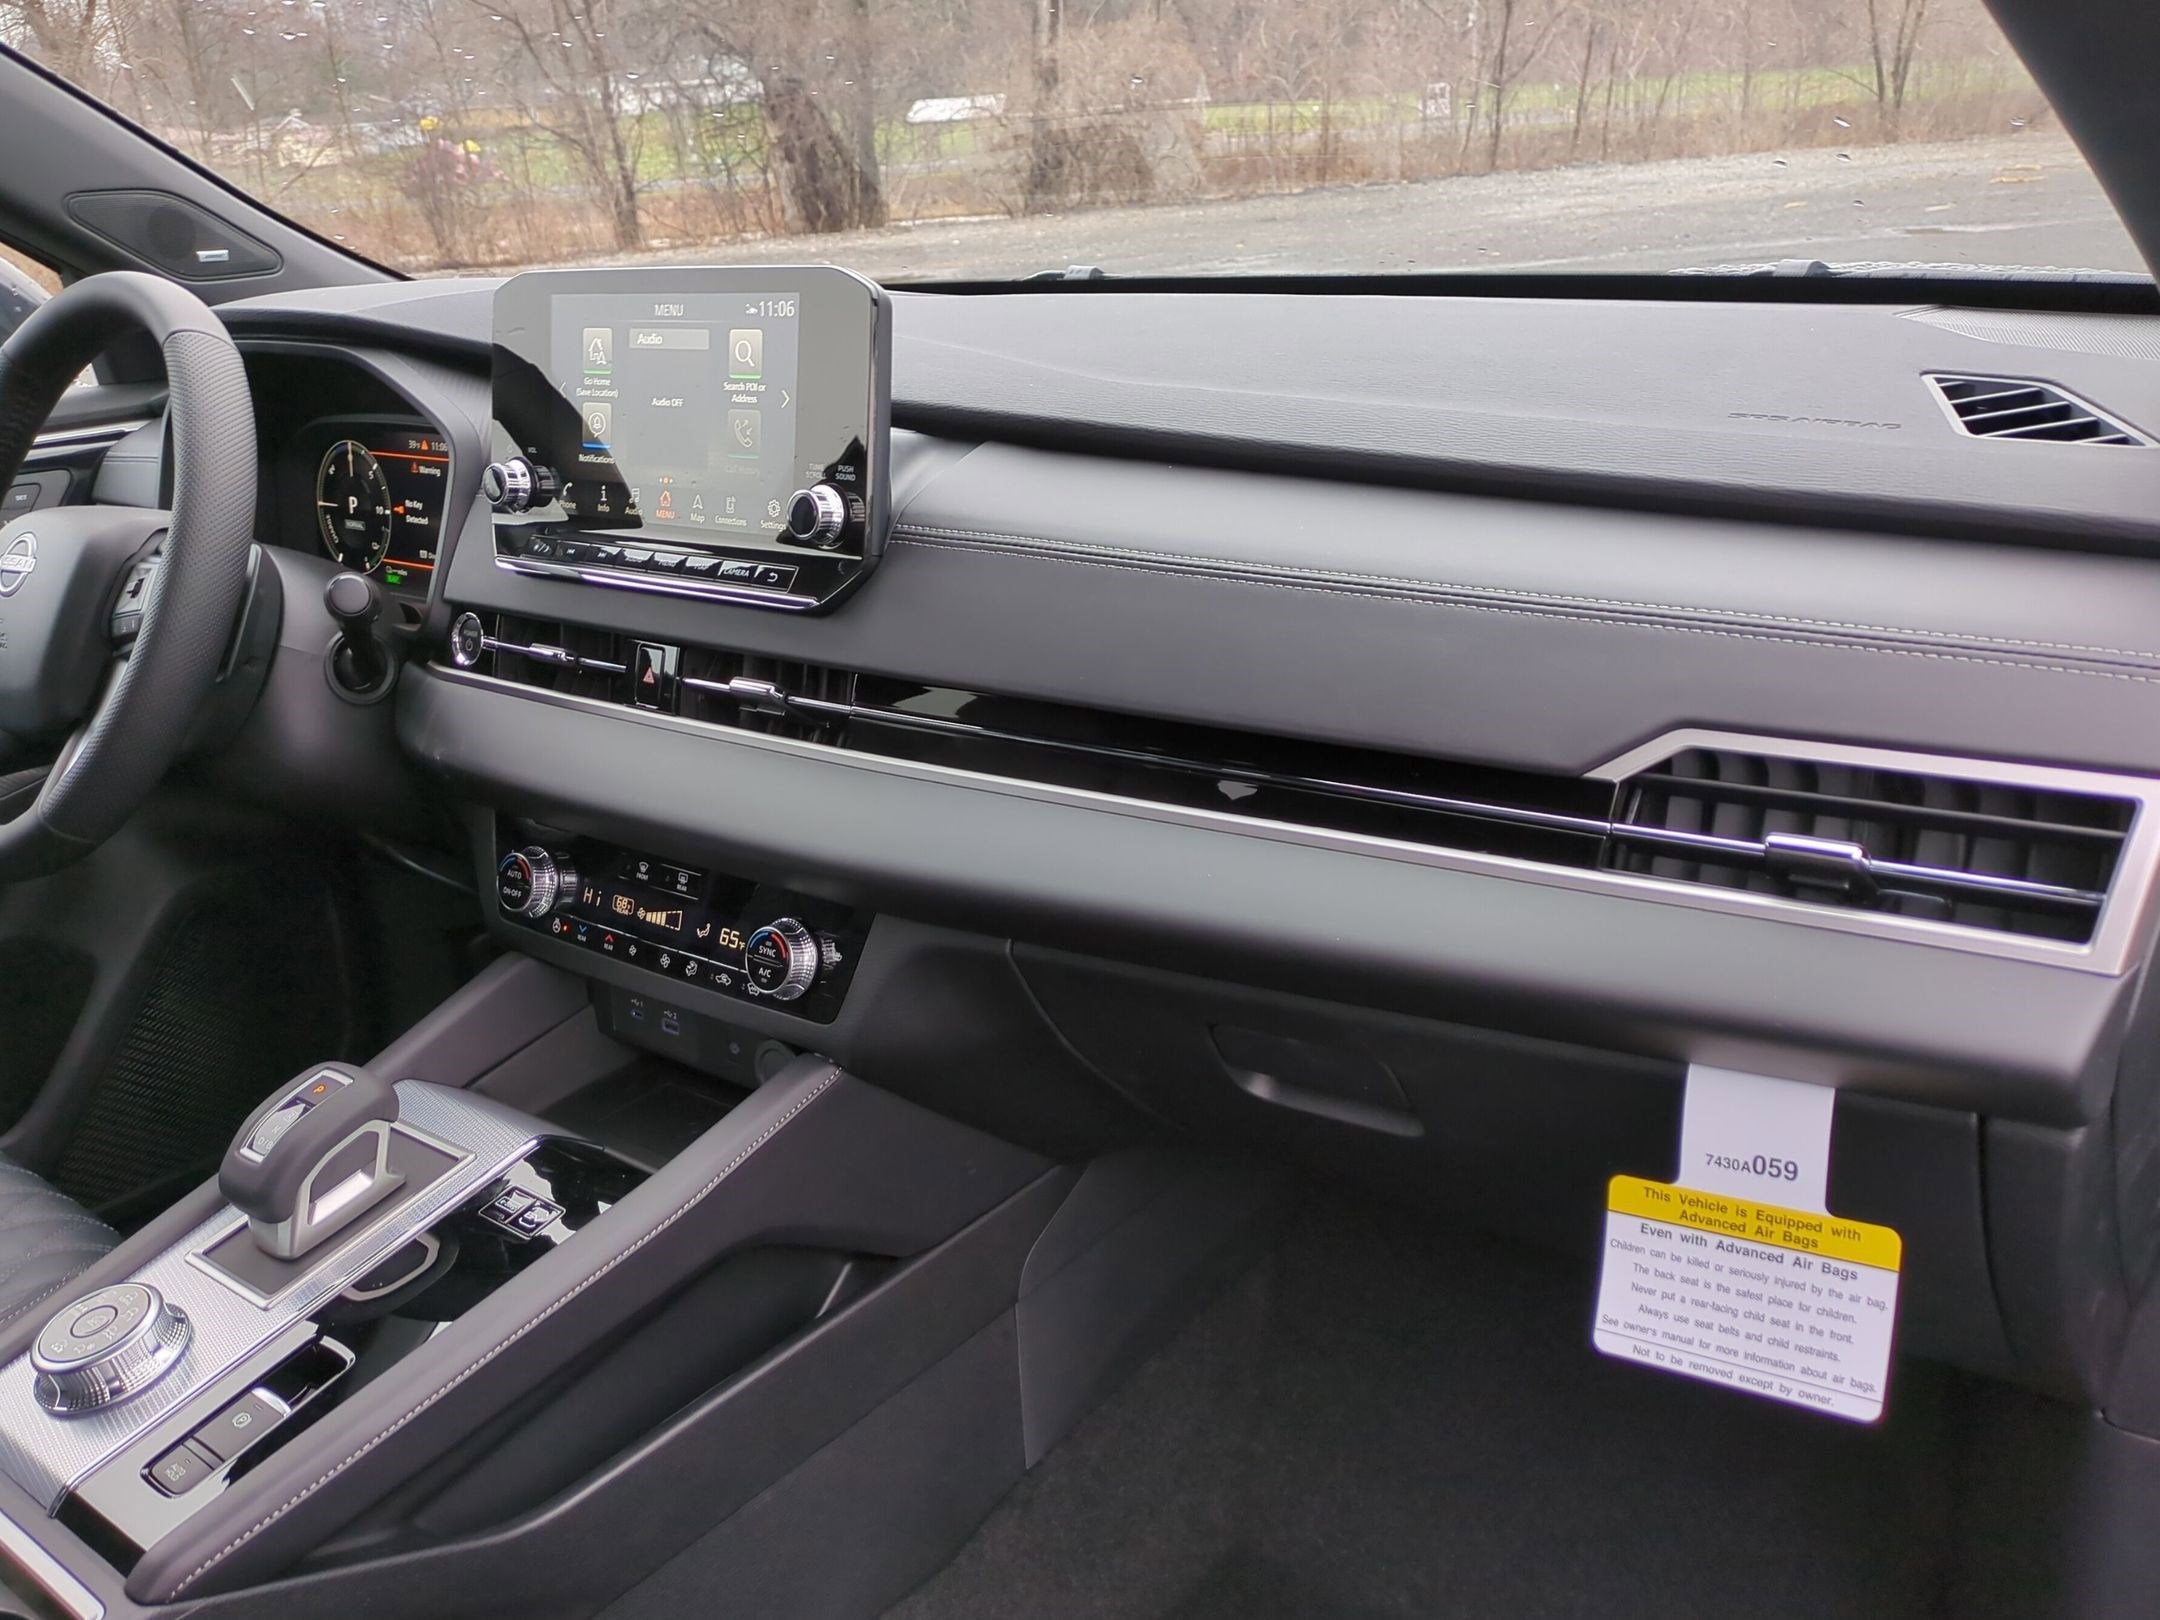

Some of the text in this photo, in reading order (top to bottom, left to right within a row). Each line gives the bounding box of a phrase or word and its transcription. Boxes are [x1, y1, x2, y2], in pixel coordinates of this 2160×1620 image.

[654, 303, 684, 317] MENU
[758, 300, 795, 318] 11:06
[636, 332, 663, 346] Audio
[583, 376, 612, 387] Go Home
[723, 381, 745, 391] Search
[651, 397, 685, 408] Audio OFF
[731, 394, 758, 404] Address
[578, 453, 616, 465] Notifications
[838, 464, 854, 473] PUSH
[835, 472, 856, 482] SOUND
[348, 495, 358, 514] P
[559, 500, 577, 510] Phone
[597, 503, 610, 514] Info
[625, 507, 644, 517] Audio
[656, 509, 676, 520] MENU
[689, 512, 705, 524] Map
[714, 515, 748, 527] Connections
[760, 519, 787, 531] Settings
[723, 567, 750, 577] CAMERA
[507, 869, 522, 880] AUTO
[758, 944, 776, 958] SYNC
[758, 967, 772, 979] A/C
[1705, 1152, 1799, 1182] 7430A059
[1644, 1186, 1861, 1242] This Vehicle is Equipped with
[1679, 1209, 1819, 1249] Advanced Air Bags
[1640, 1222, 1859, 1281] Even with Advanced Air Bags
[1610, 1237, 1888, 1312] Children can be killed or seriously injured by the air bag.
[1633, 1262, 1857, 1325] The back seat is the safest place for children.
[1631, 1281, 1855, 1345] Never put a rear-facing child seat in the front.
[1638, 1303, 1841, 1362] Always use seat belts and child restraints.
[1602, 1313, 1619, 1327] See
[1661, 1330, 1695, 1346] manual
[1698, 1339, 1712, 1351] for
[1715, 1344, 1740, 1358] more
[1744, 1350, 1796, 1373] information
[1799, 1364, 1828, 1381] about
[1831, 1373, 1845, 1384] air
[1849, 1377, 1877, 1394] bags.
[1632, 1343, 1835, 1408] Not to be removed except by owner.
